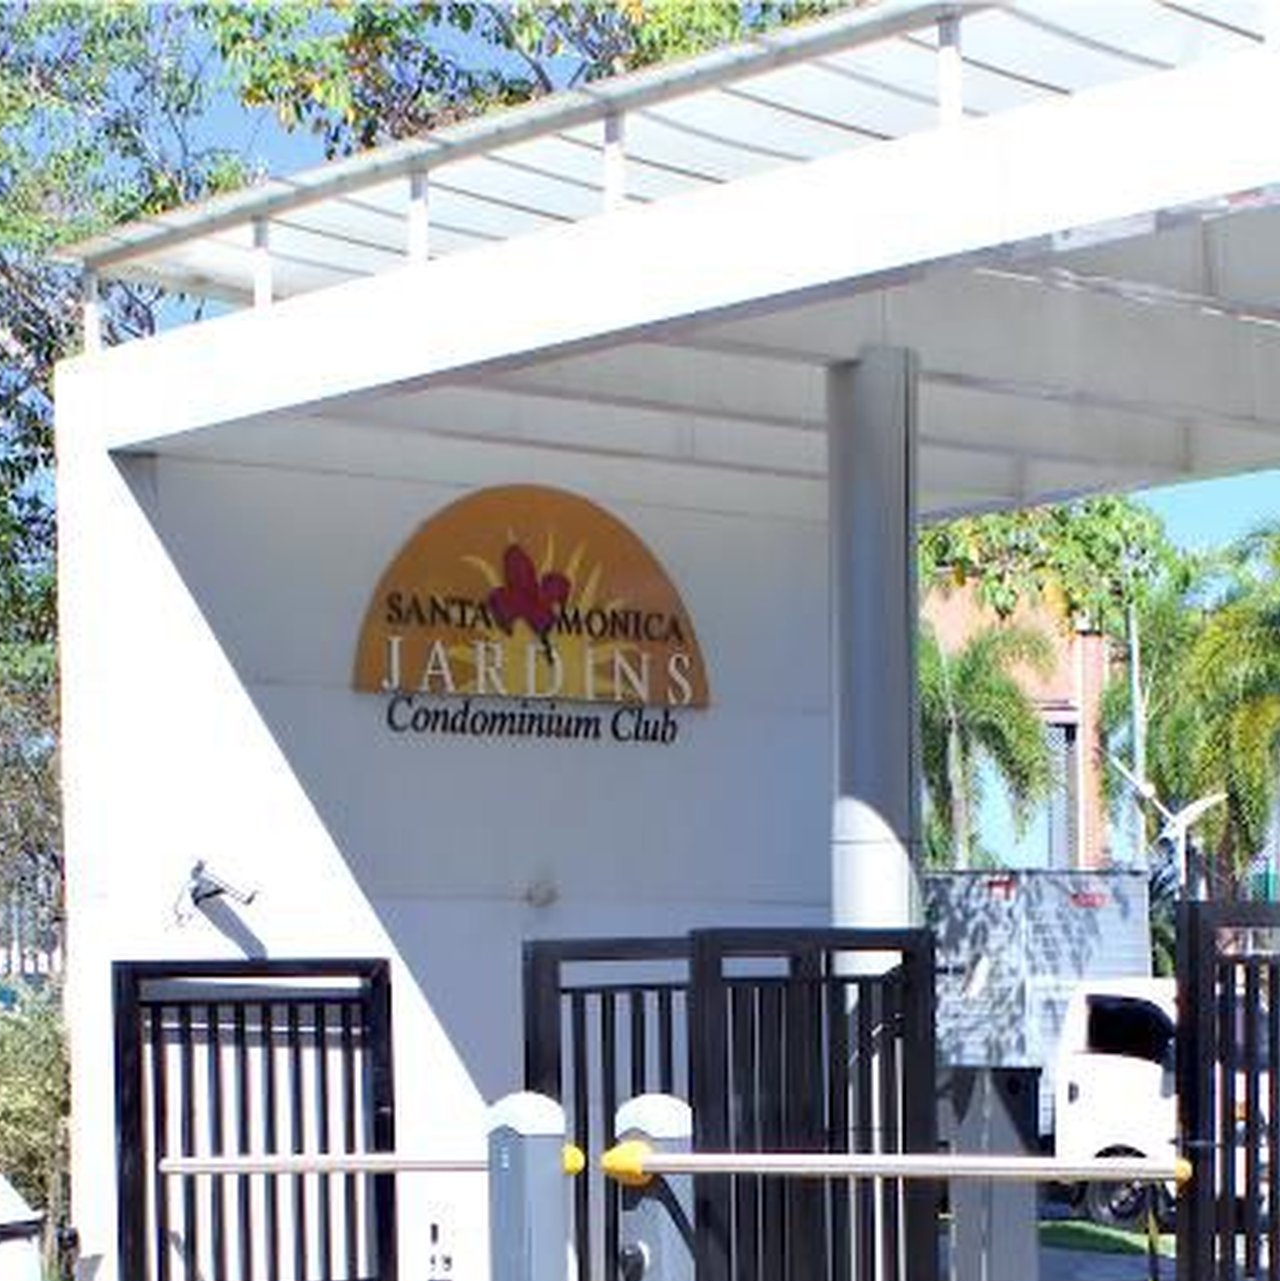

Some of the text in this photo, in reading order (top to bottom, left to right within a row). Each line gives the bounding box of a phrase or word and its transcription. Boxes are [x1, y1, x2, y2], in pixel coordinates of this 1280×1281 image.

[386, 591, 683, 641] SANTA MONICA
[380, 635, 693, 705] JARDINS
[386, 694, 678, 744] Condominium Club
